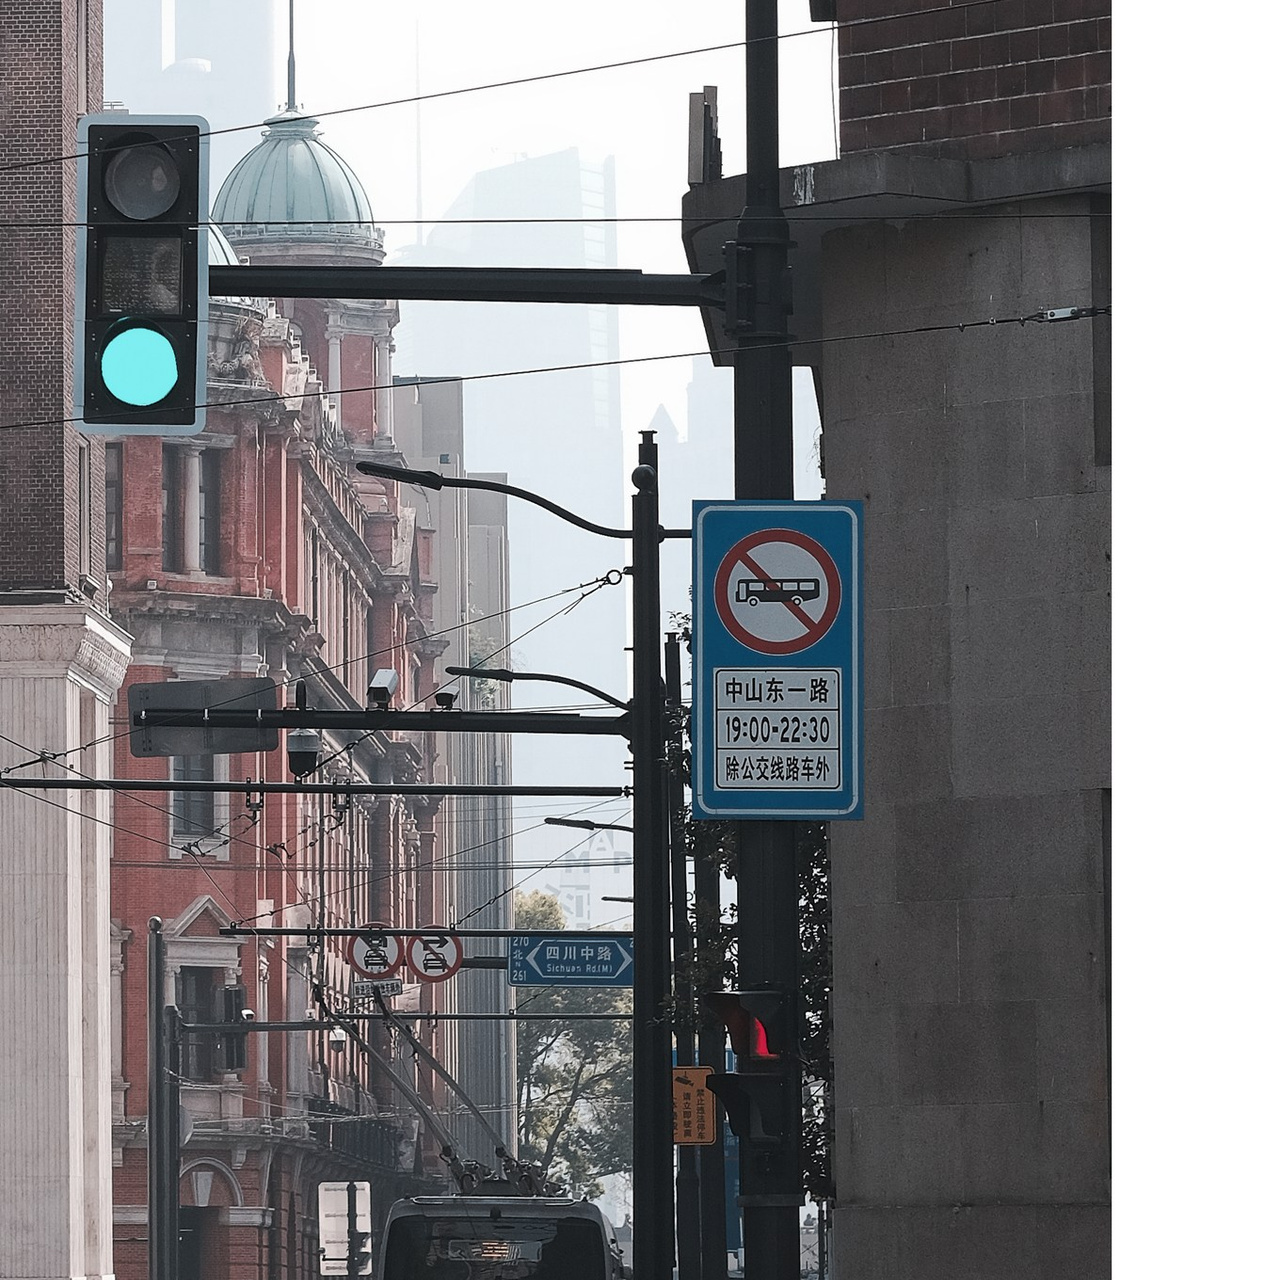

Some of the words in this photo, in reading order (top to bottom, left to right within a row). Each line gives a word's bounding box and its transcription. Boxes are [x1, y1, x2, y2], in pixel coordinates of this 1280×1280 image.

[725, 677, 830, 704] 中山东一路
[725, 716, 830, 743] 19:00-22:30
[725, 755, 830, 782] 除公交线路车外
[513, 949, 523, 960] 北
[546, 946, 612, 961] 四川中路
[512, 969, 527, 981] 261
[546, 963, 582, 973] Sichuan
